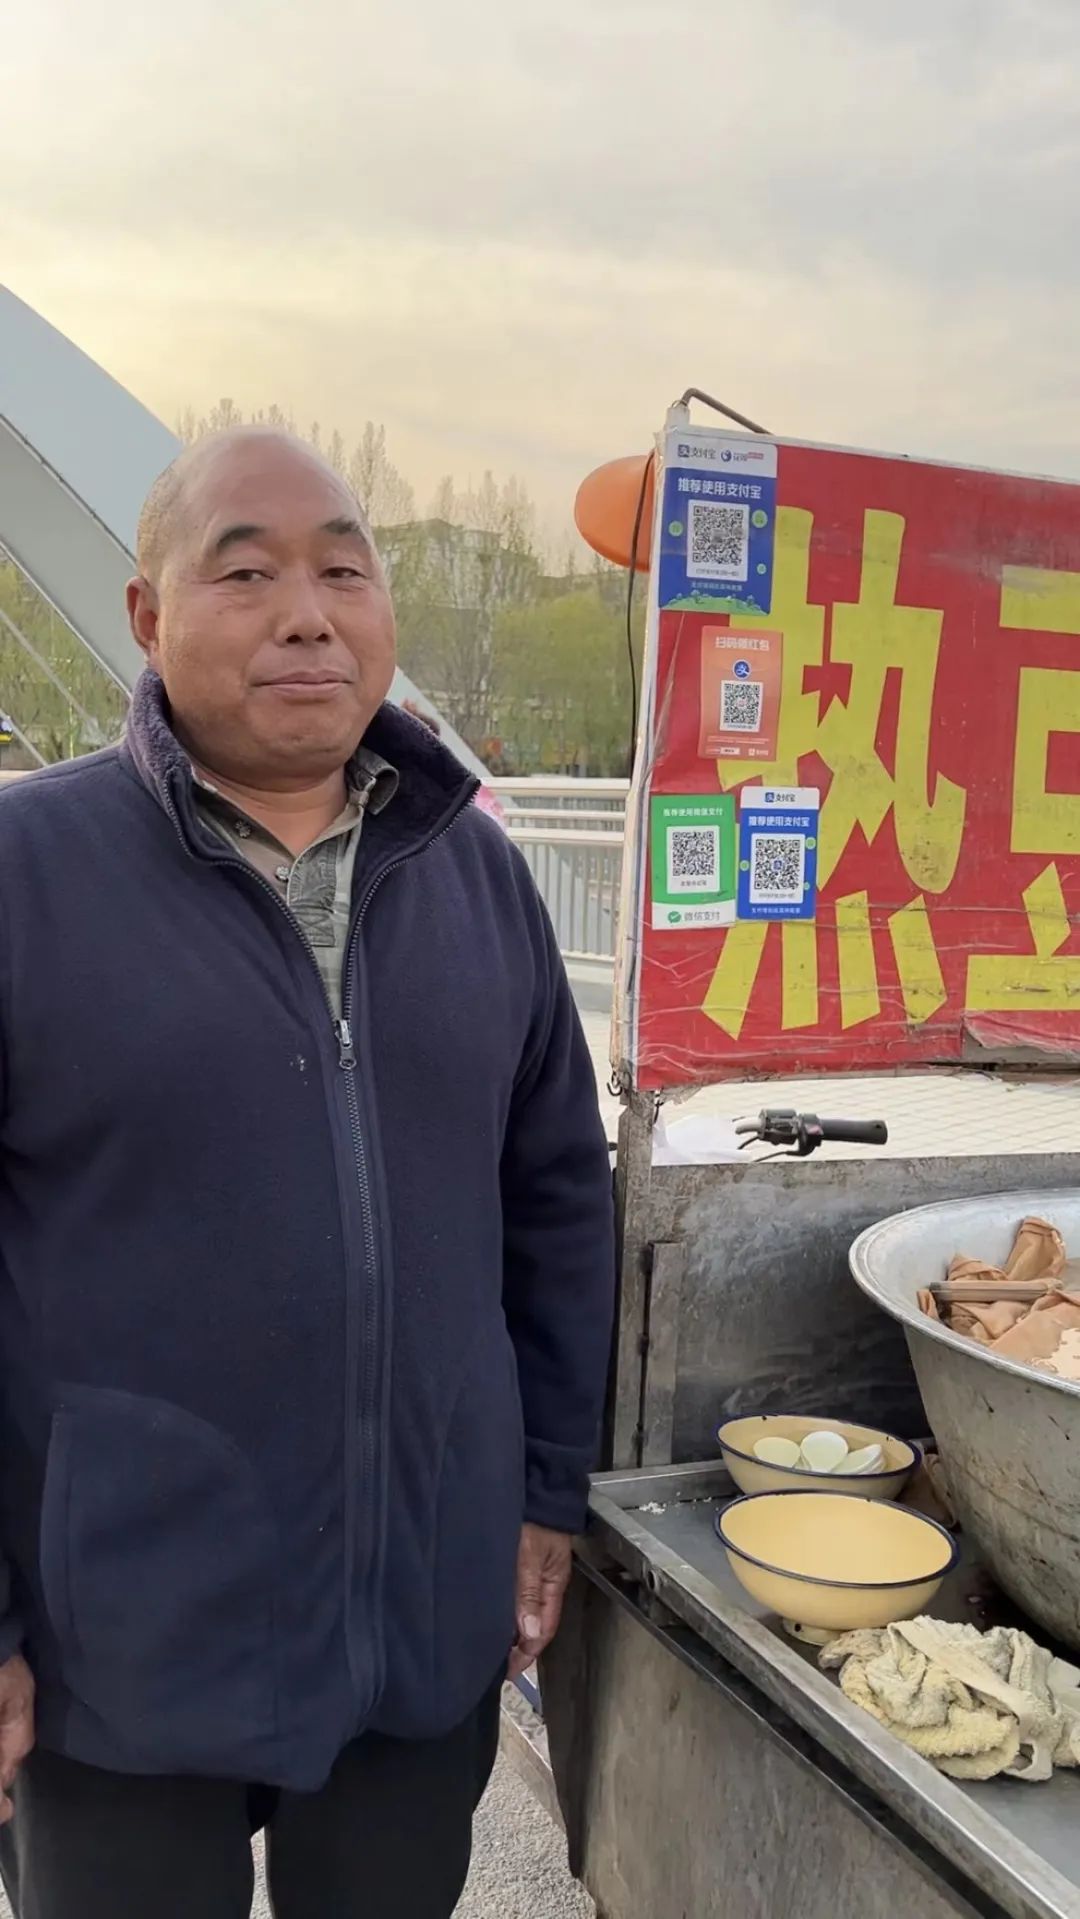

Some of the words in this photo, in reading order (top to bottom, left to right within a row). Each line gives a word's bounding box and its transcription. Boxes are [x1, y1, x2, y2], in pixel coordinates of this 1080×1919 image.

[678, 477, 762, 500] 推荐使用支付宝
[748, 815, 811, 828] 推荐使用支付宝
[684, 911, 721, 921] 微信支付
